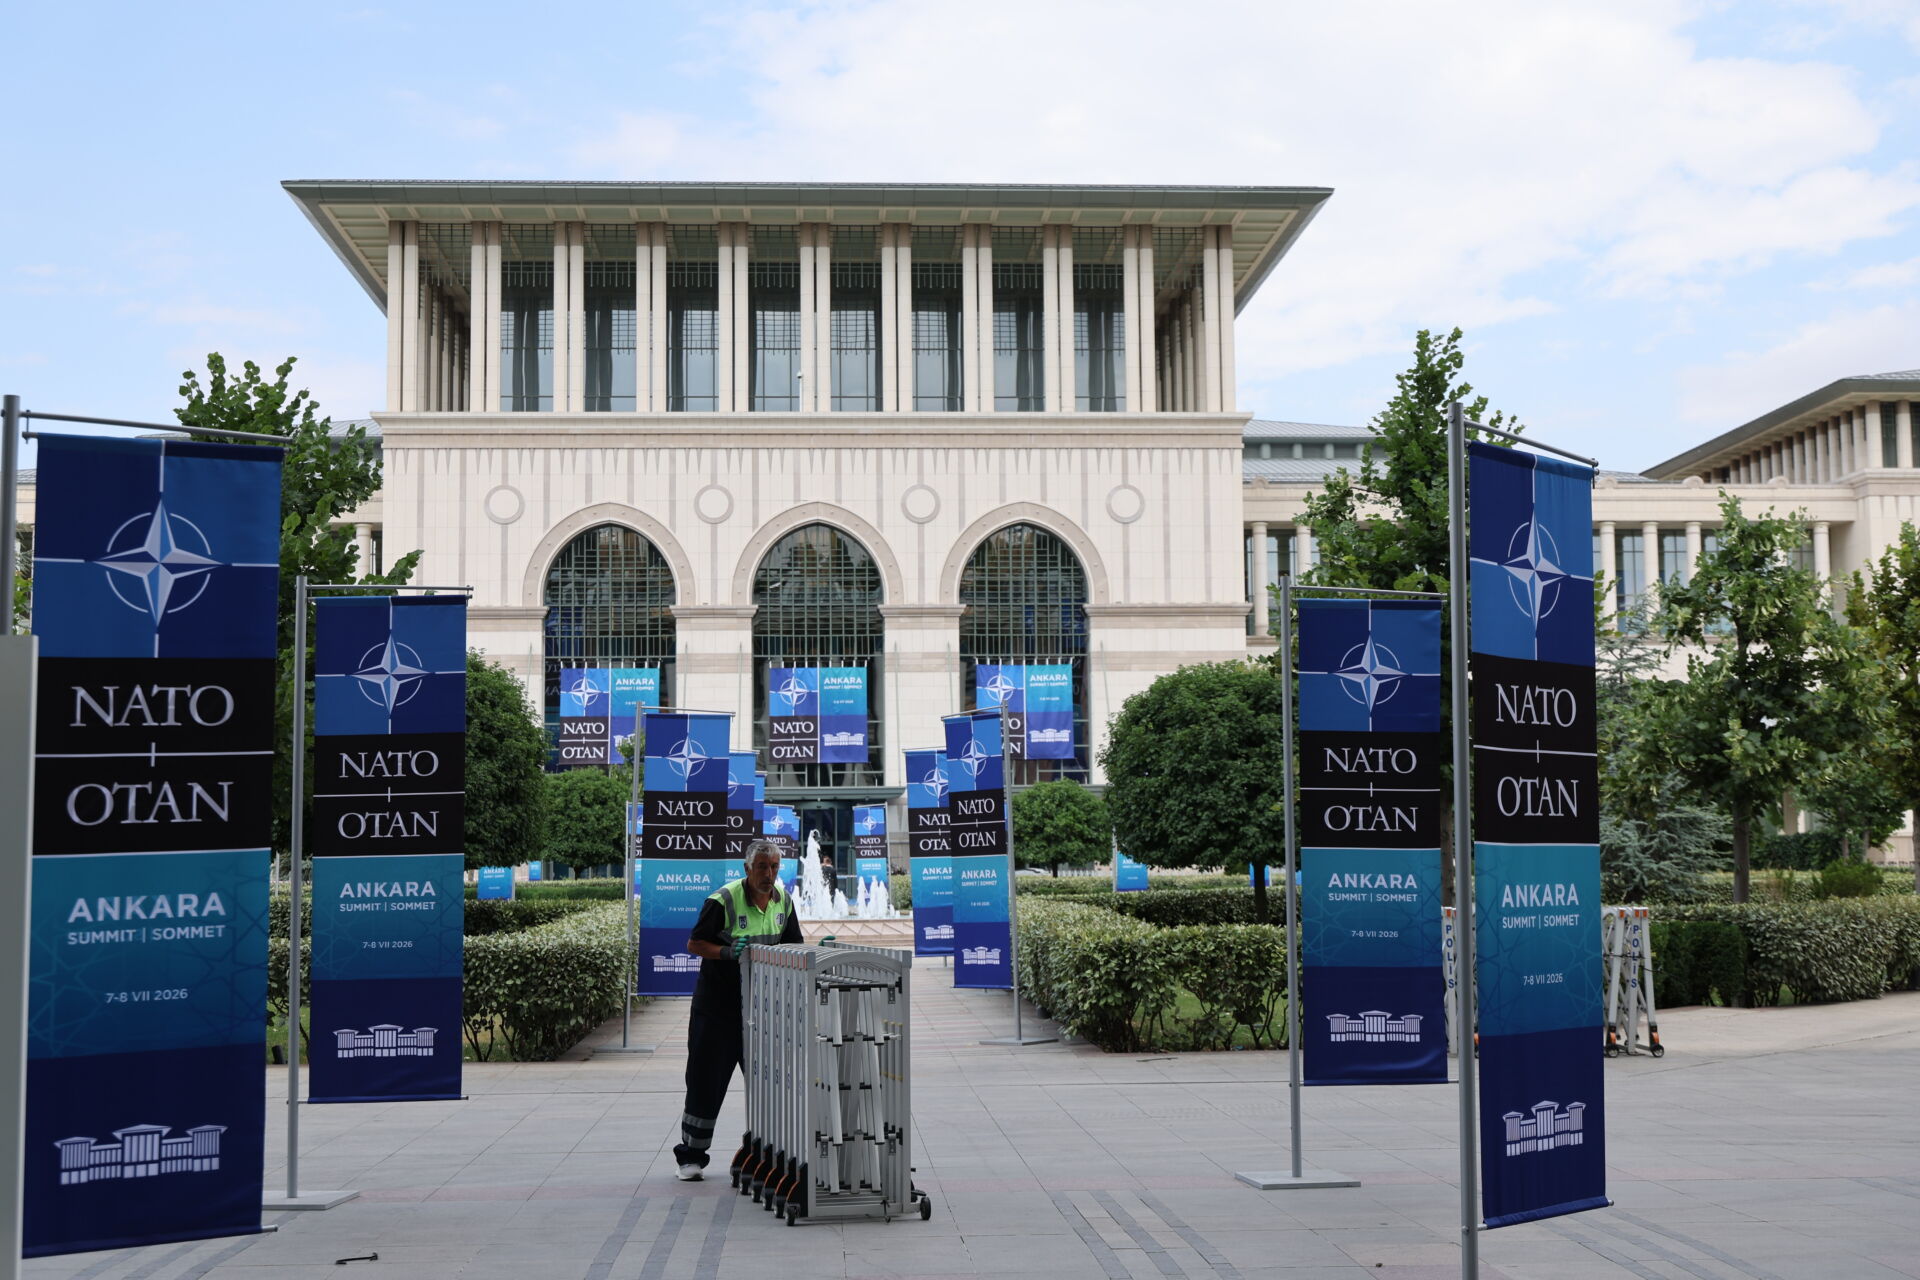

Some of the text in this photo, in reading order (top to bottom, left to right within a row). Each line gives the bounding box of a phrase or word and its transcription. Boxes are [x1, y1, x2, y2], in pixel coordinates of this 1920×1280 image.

[616, 678, 655, 686] ANKARA
[1030, 674, 1068, 682] ANKARA
[70, 684, 235, 727] NATO
[1496, 683, 1577, 727] NATO
[563, 722, 605, 735] NATO
[773, 721, 814, 734] NATO
[562, 747, 604, 759] OTAN
[772, 746, 814, 759] OTAN
[339, 750, 439, 778] NATO
[1323, 747, 1417, 774] NATO
[66, 781, 234, 826] OTAN
[1497, 775, 1579, 818] OTAN
[657, 801, 714, 816] NATO
[958, 798, 995, 815] NATO
[338, 811, 439, 839] OTAN
[1323, 805, 1419, 832] OTAN
[656, 834, 713, 850] OTAN
[920, 838, 951, 851] OTA
[959, 831, 997, 848] OTAN
[656, 874, 711, 884] ANKARA
[962, 869, 997, 880] ANKARA
[1328, 873, 1417, 889] ANKARA
[339, 881, 436, 898] ANKARA
[1502, 883, 1579, 908] ANKARA
[1328, 893, 1368, 902] SUMMIT
[1376, 894, 1417, 902] SOMMET
[67, 892, 226, 923] ANKARA
[339, 902, 381, 912] SUMMIT
[390, 902, 436, 911] SOMMET
[1502, 915, 1536, 929] SUMMIT
[1544, 914, 1579, 927] SOMMET
[67, 929, 137, 945] SUMMIT
[152, 924, 226, 941] SOMMET
[392, 940, 413, 948] 2026
[1524, 973, 1563, 986] 7-8 VII 2026
[106, 988, 188, 1003] 7-8 VII 2026
